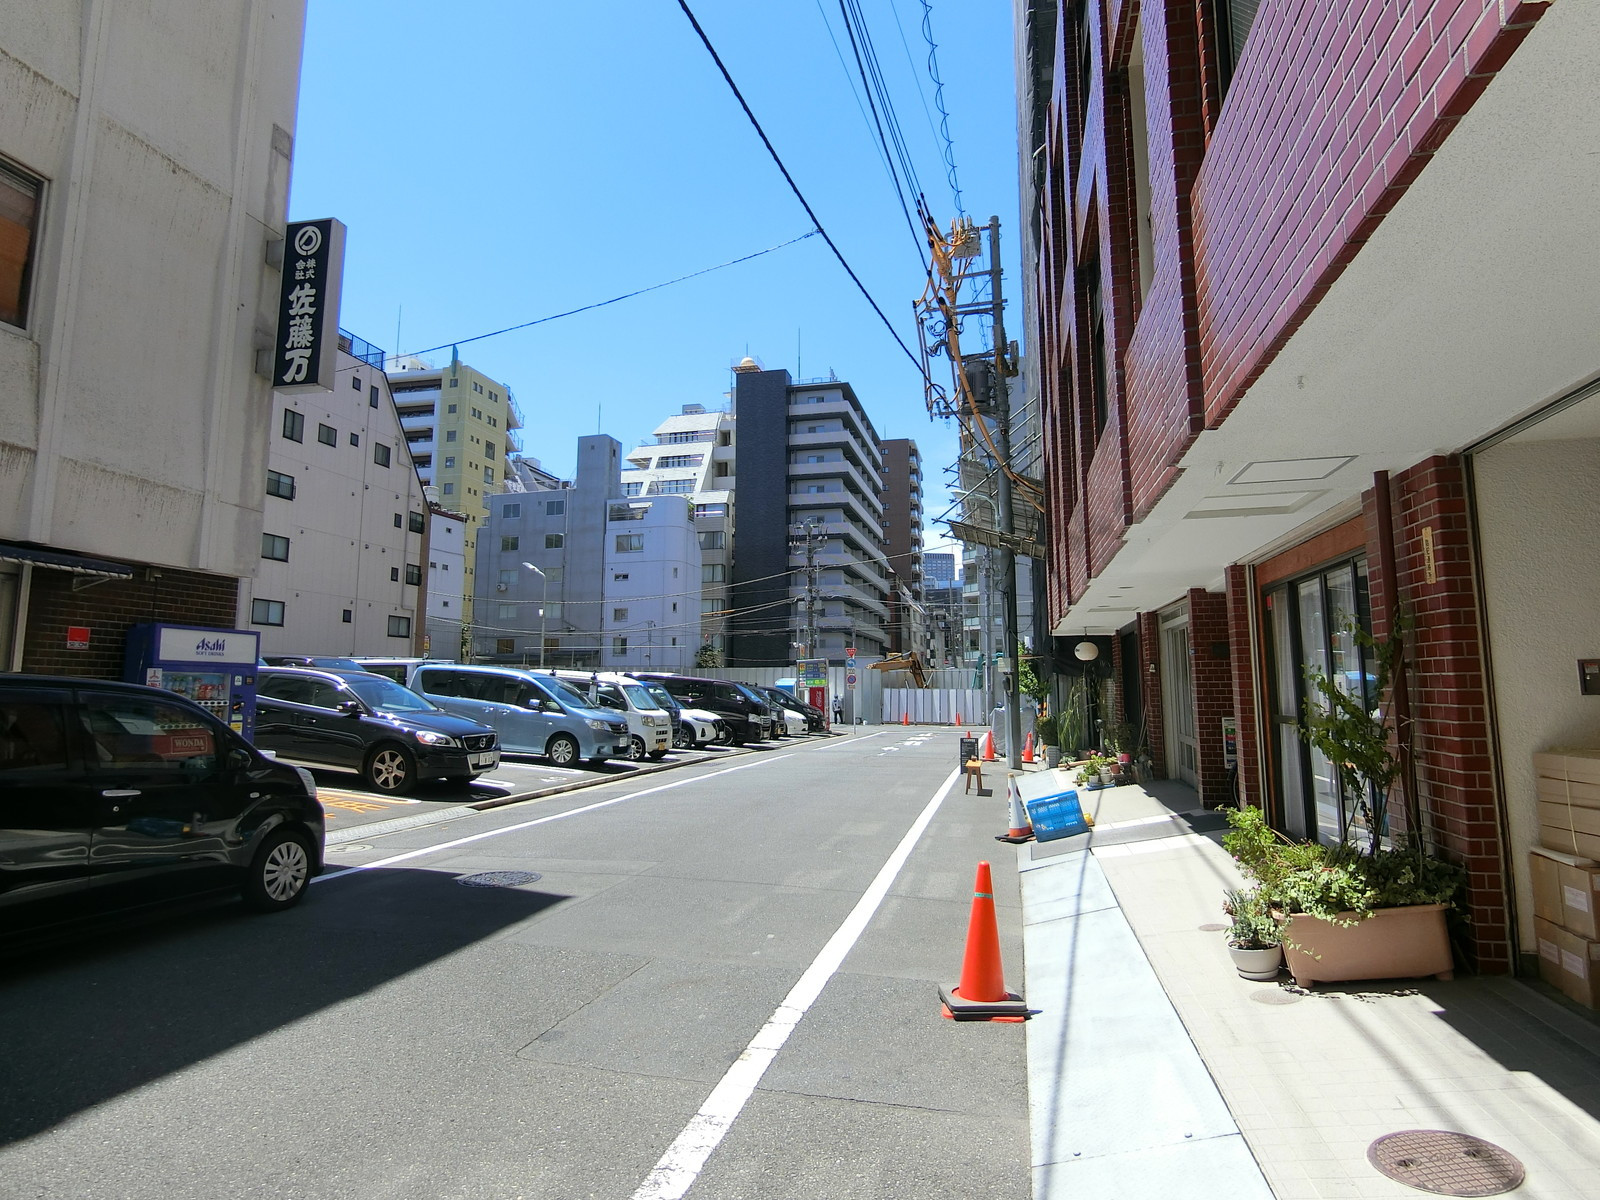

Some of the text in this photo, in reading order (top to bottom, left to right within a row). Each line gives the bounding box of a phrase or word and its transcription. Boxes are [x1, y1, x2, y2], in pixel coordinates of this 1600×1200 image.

[282, 282, 317, 383] 佐藤万
[196, 637, 225, 652] Asahi
[174, 738, 205, 747] WONDA
